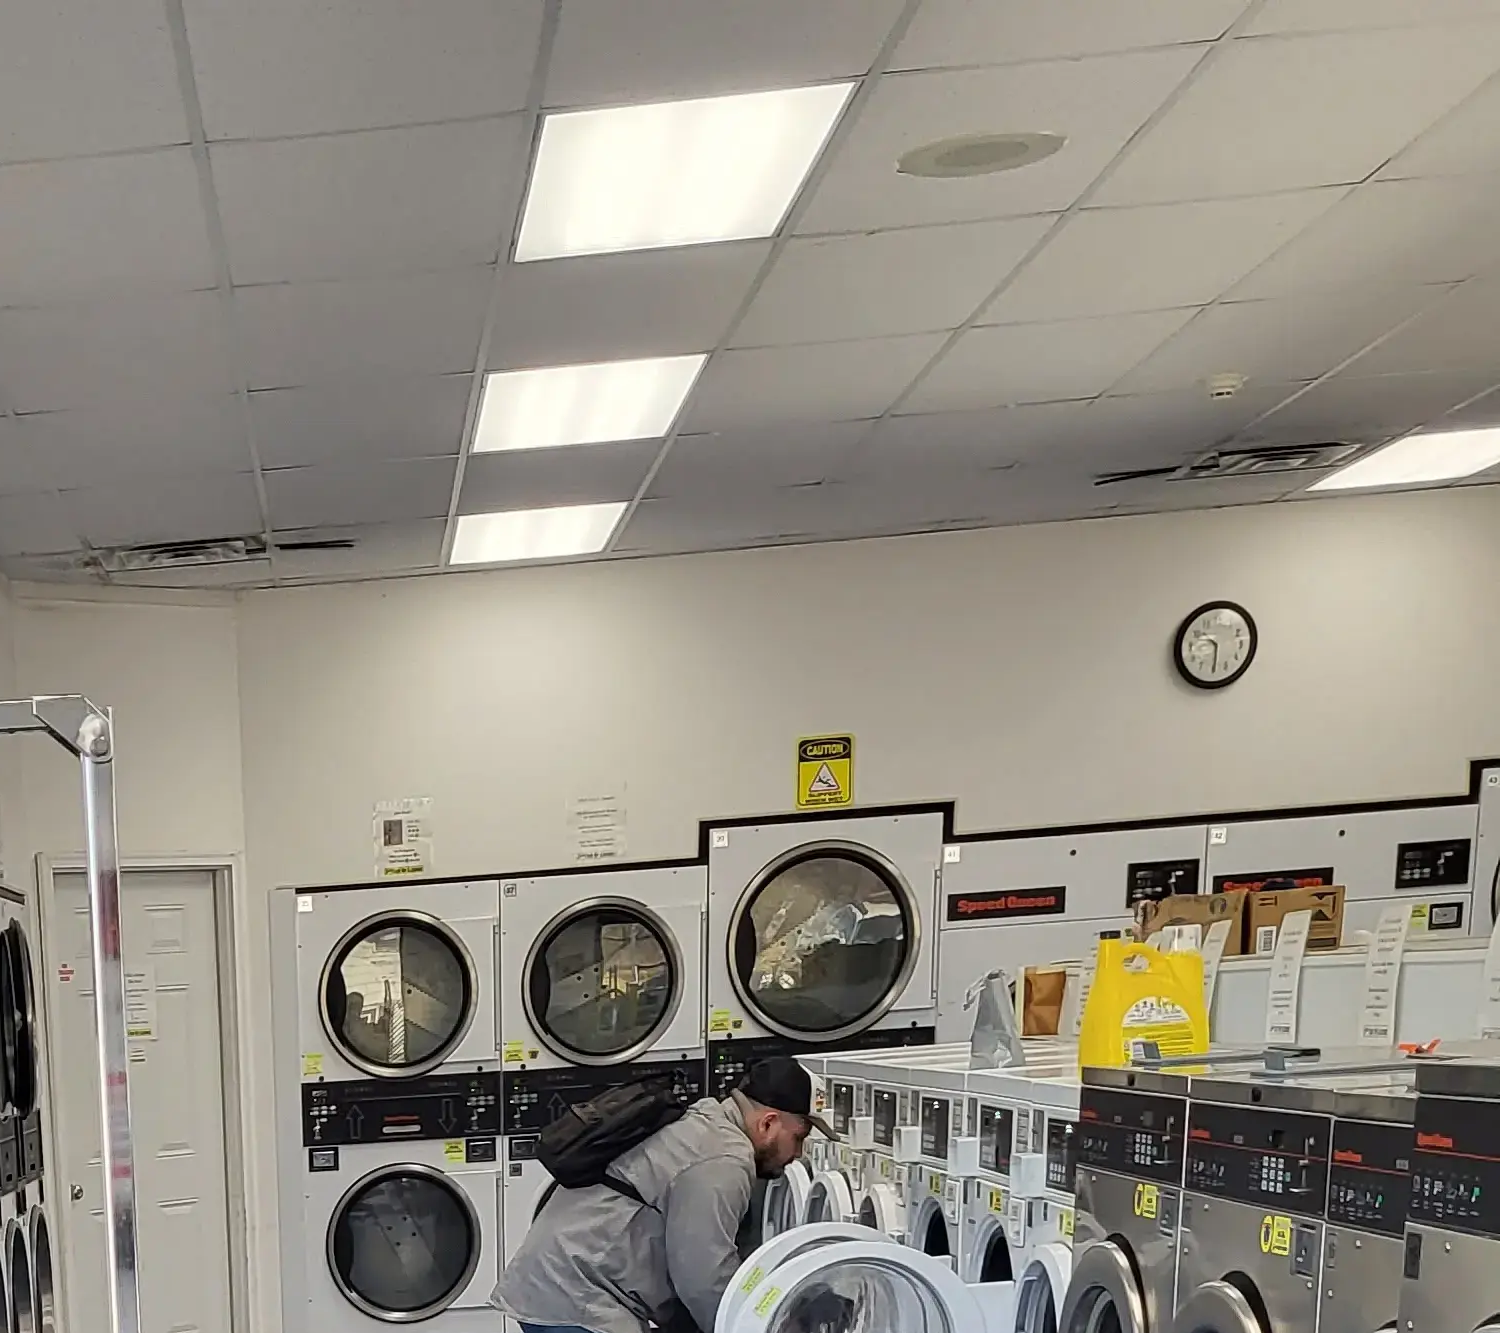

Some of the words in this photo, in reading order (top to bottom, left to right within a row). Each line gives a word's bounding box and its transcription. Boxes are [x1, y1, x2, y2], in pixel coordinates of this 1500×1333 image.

[806, 744, 844, 756] CAUTION
[957, 896, 1006, 914] Speed
[1007, 895, 1056, 909] Queen
